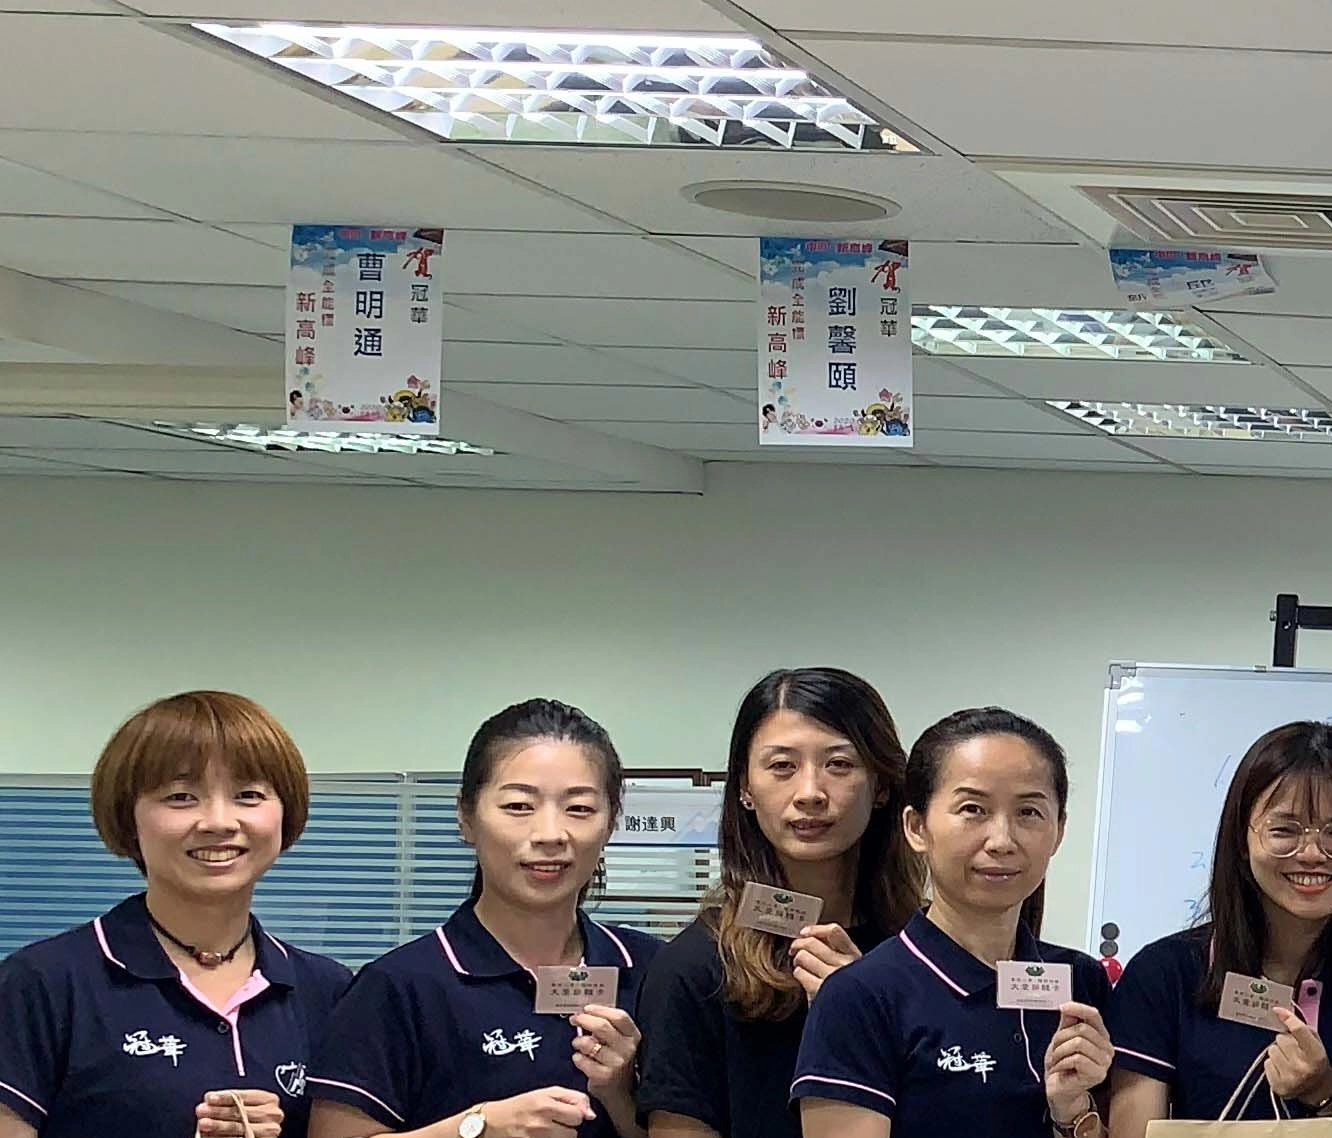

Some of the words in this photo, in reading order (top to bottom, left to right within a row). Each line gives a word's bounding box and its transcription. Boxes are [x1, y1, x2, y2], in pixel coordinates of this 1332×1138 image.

[402, 247, 433, 280] 賀
[870, 260, 902, 293] 賀
[354, 253, 386, 357] 曹明通
[410, 284, 429, 324] 冠華
[880, 297, 898, 337] 冠華
[295, 292, 317, 366] 新高峰
[767, 305, 787, 380] 新高峰
